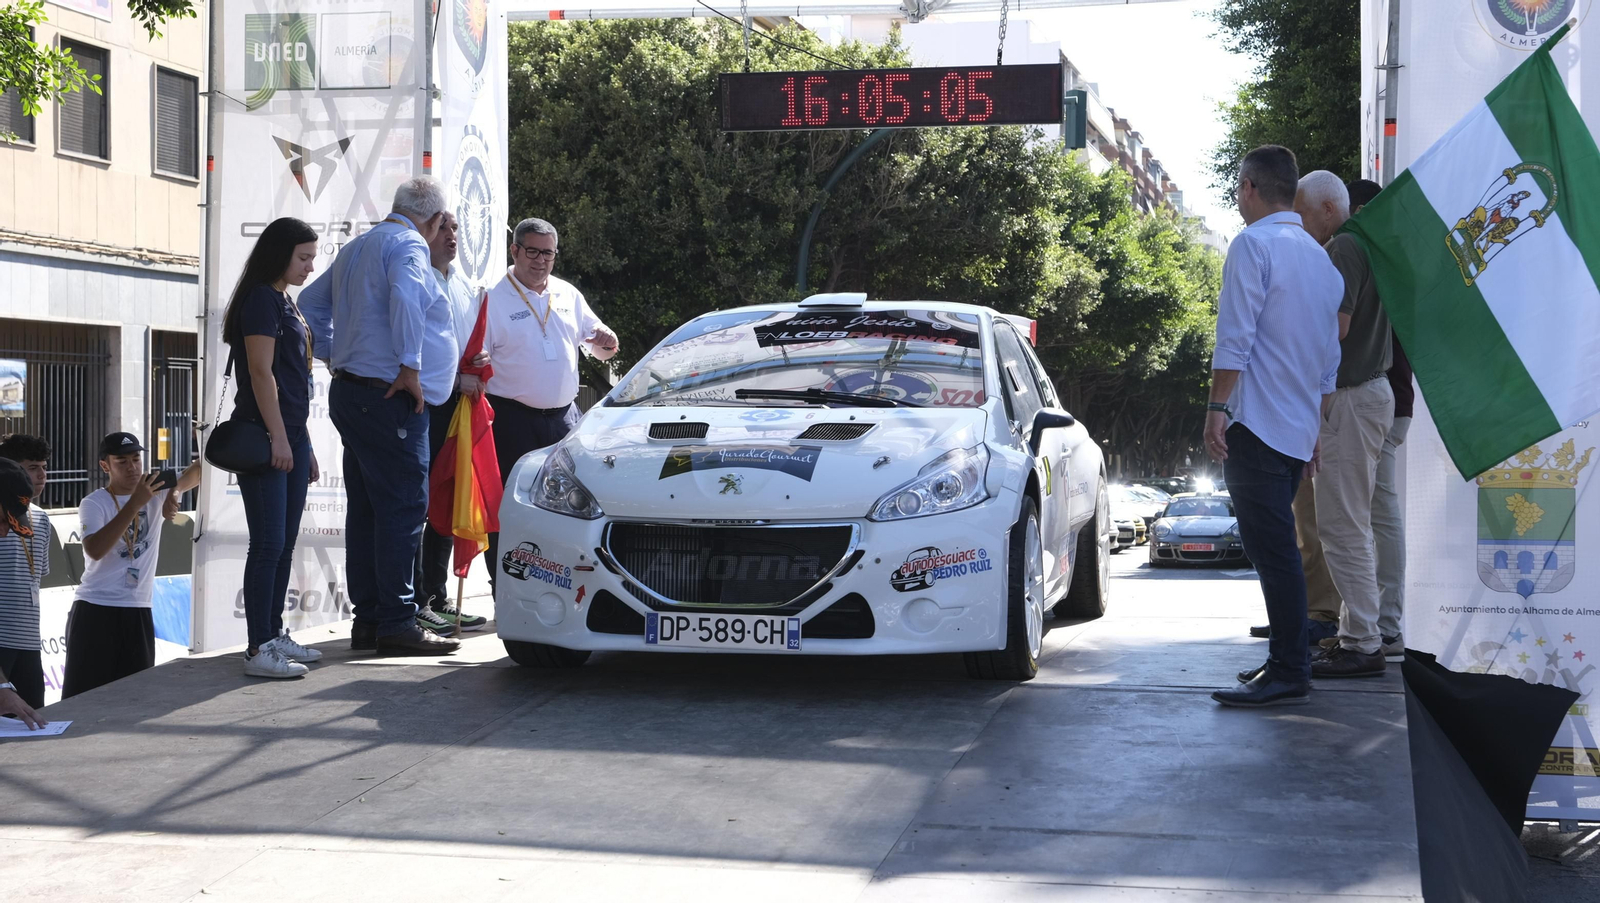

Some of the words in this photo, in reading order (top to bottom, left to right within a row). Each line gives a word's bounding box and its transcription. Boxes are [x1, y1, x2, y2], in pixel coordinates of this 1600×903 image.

[1500, 33, 1547, 47] ALMER
[253, 42, 307, 62] UNED
[781, 71, 993, 126] 16:05:05
[511, 549, 564, 574] AUTODESGUACE
[901, 549, 976, 574] AUTODESGUACE
[932, 563, 967, 581] PEDRO
[969, 558, 993, 574] RUIZ
[530, 565, 555, 584] PEDRO
[555, 575, 573, 590] RUIZ
[1438, 605, 1507, 616] Ayuntamiento
[1508, 606, 1521, 614] de
[1523, 606, 1559, 615] Alhama
[1561, 607, 1574, 616] de
[1576, 607, 1600, 617] Alme
[789, 639, 799, 647] 32
[1539, 764, 1582, 772] CONTRA
